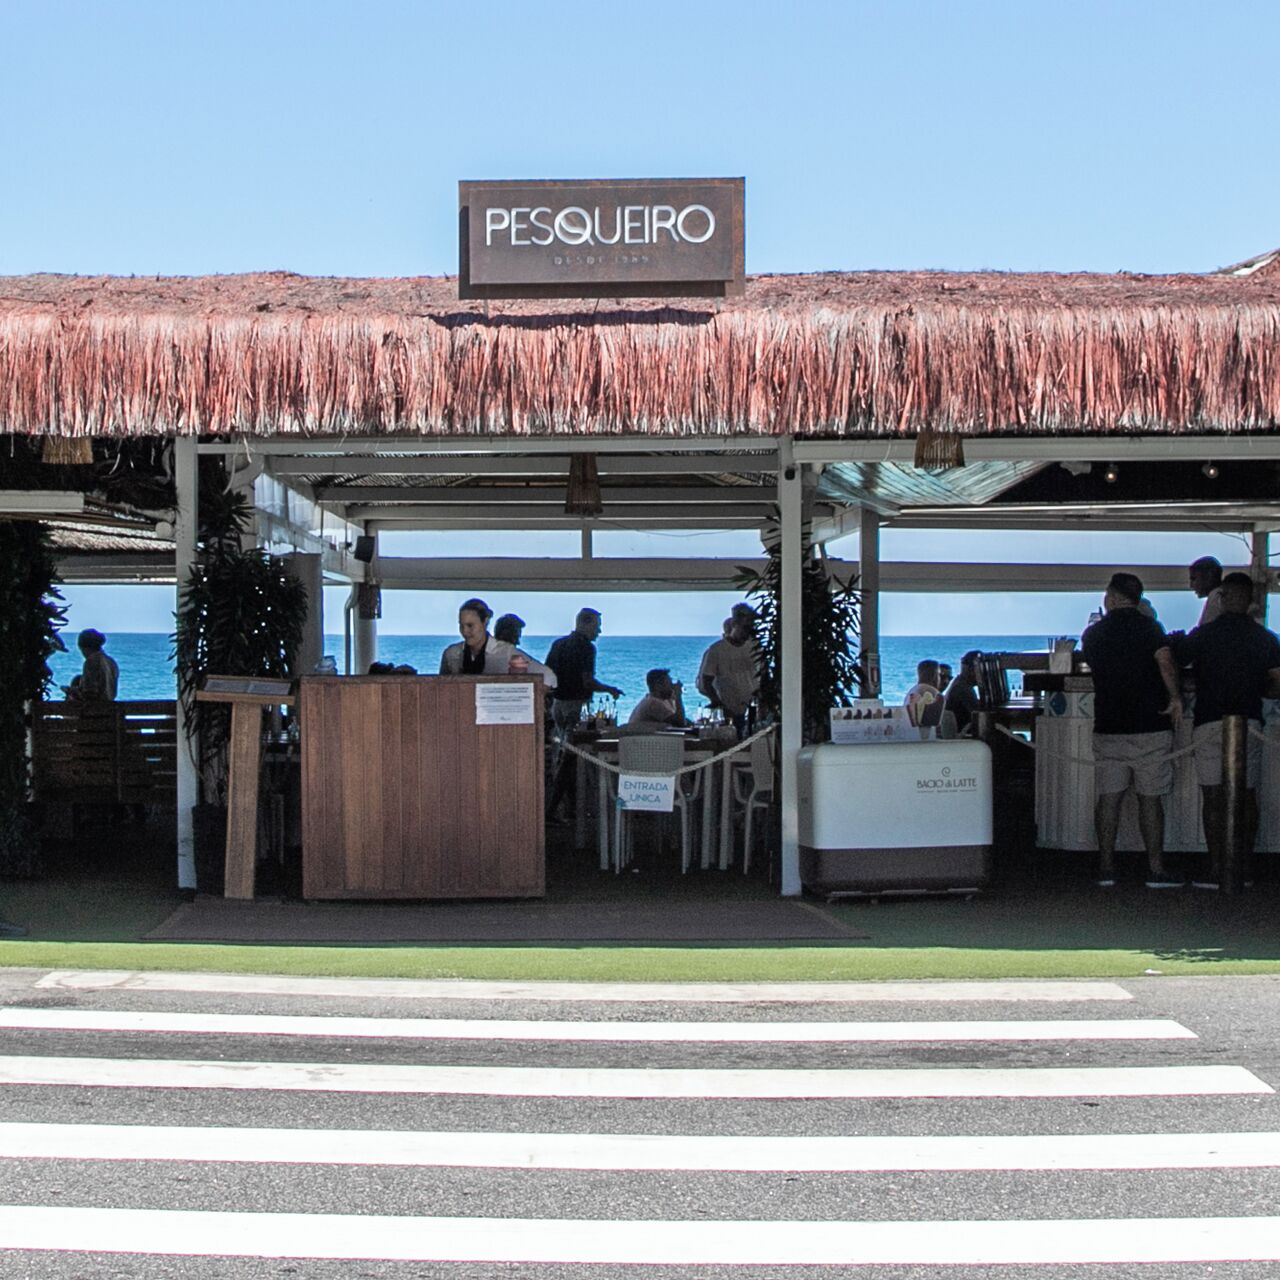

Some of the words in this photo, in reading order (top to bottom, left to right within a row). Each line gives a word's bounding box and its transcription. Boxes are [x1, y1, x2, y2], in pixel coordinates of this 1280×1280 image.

[486, 204, 716, 247] PESQUEIRO
[623, 780, 669, 792] ENTRADA
[917, 779, 944, 789] BACIO
[953, 777, 977, 788] LATTE
